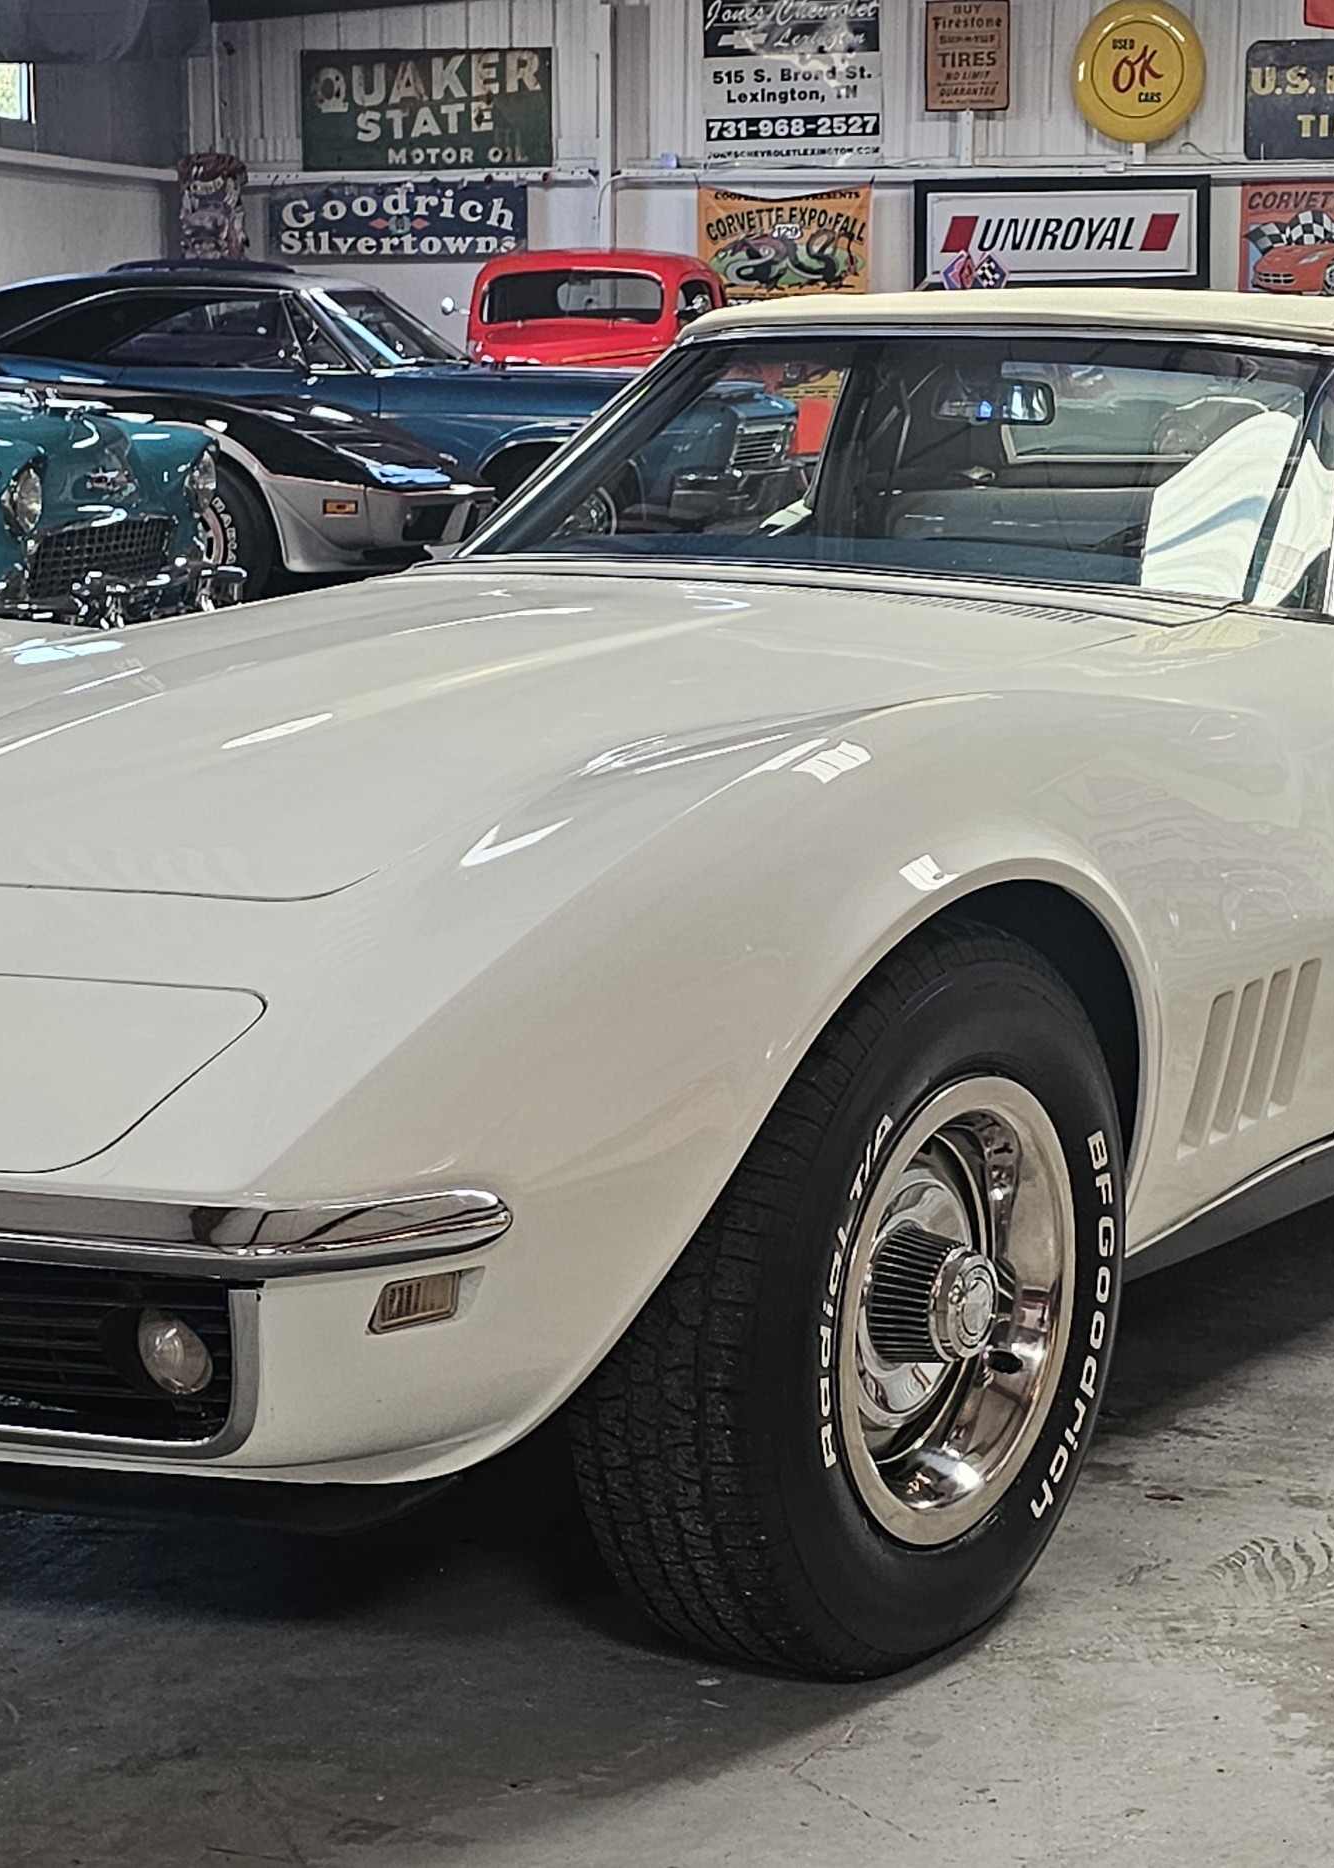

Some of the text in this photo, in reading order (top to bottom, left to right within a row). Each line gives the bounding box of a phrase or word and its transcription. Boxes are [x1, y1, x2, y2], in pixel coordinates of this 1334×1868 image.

[953, 4, 982, 14] BUY
[932, 16, 1003, 30] Firestone
[1112, 39, 1135, 50] USED
[937, 51, 997, 68] TIRES
[1112, 44, 1165, 94] OK
[311, 50, 542, 113] QUAKER
[713, 65, 872, 84] 515 S. Brod St.
[1250, 66, 1316, 95] U.S.
[727, 85, 858, 104] Lexington, TN
[1138, 92, 1161, 103] CARS
[357, 100, 494, 142] STATE
[708, 116, 877, 139] 731-968-2527
[388, 147, 529, 165] MOTOR OIL
[281, 188, 514, 231] Goodrich
[706, 207, 783, 241] CORVETTE
[977, 217, 1135, 251] UNIROYAL
[280, 230, 516, 255] Silvertowns
[1031, 1130, 1116, 1520] BFGoodrich
